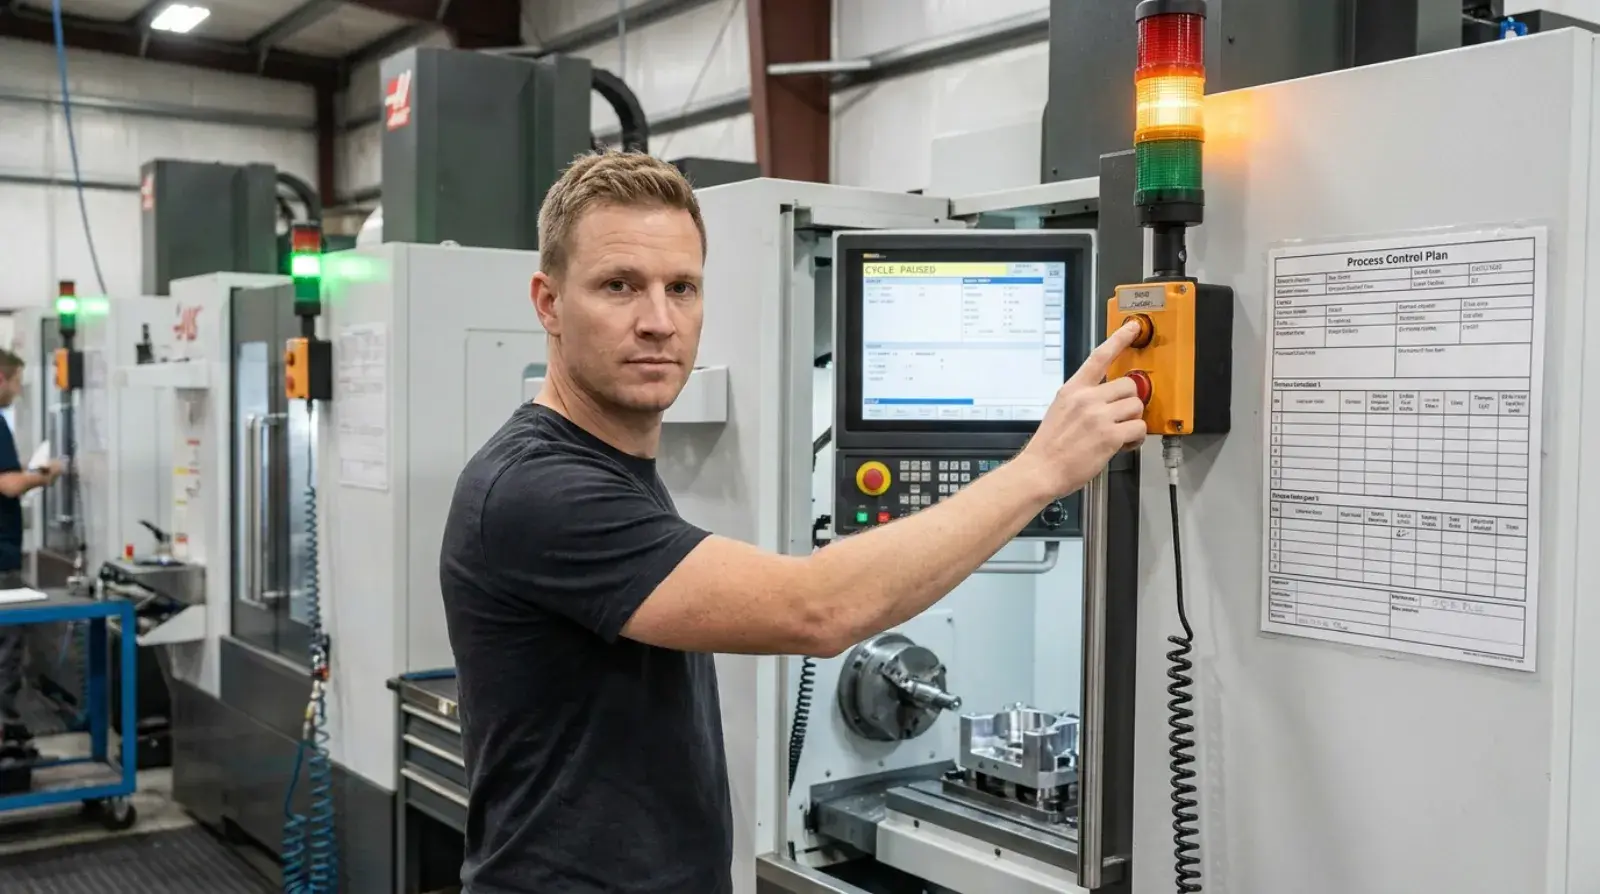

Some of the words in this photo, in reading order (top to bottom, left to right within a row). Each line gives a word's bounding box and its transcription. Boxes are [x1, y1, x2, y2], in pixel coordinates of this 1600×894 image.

[1347, 256, 1384, 267] Process
[1386, 252, 1423, 264] Control
[1426, 250, 1448, 261] Plan
[865, 265, 895, 275] CYCLE
[900, 265, 936, 275] PAUSED
